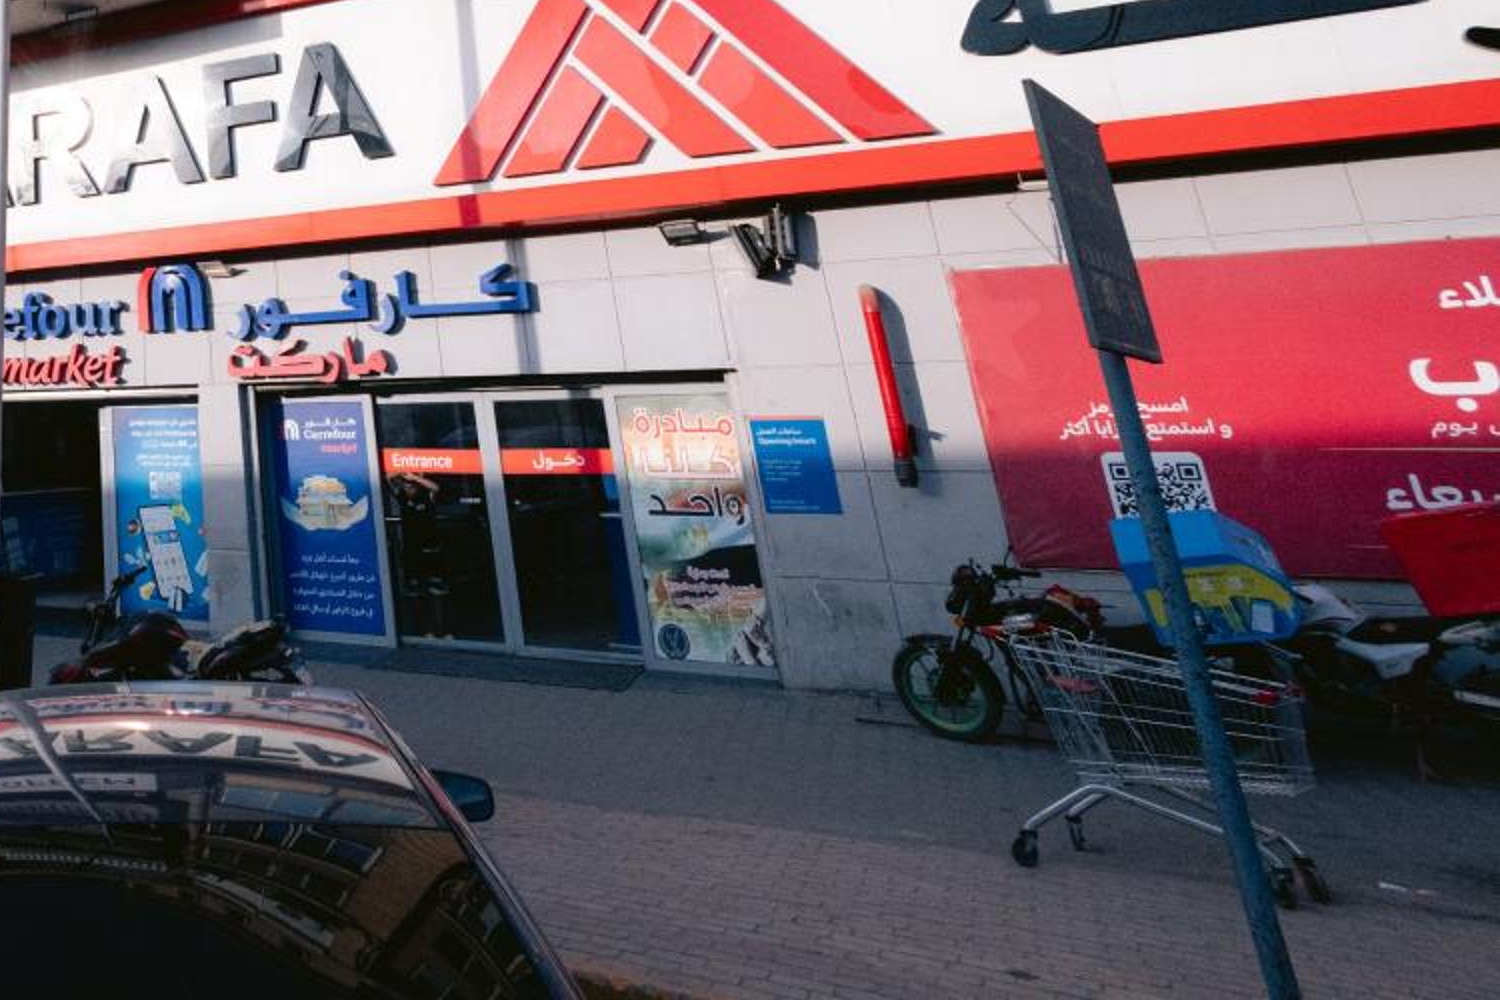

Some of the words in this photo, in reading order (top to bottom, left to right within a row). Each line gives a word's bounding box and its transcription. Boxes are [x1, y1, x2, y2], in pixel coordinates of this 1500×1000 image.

[227, 263, 535, 341] كارفور
[2, 343, 124, 387] market
[228, 336, 390, 385] ماركت
[303, 427, 357, 441] Carrefour
[633, 406, 735, 440] مبادرة
[1431, 420, 1479, 439] يوم
[391, 453, 453, 469] Entrance
[531, 451, 586, 470] دخول
[649, 486, 746, 525] واحد
